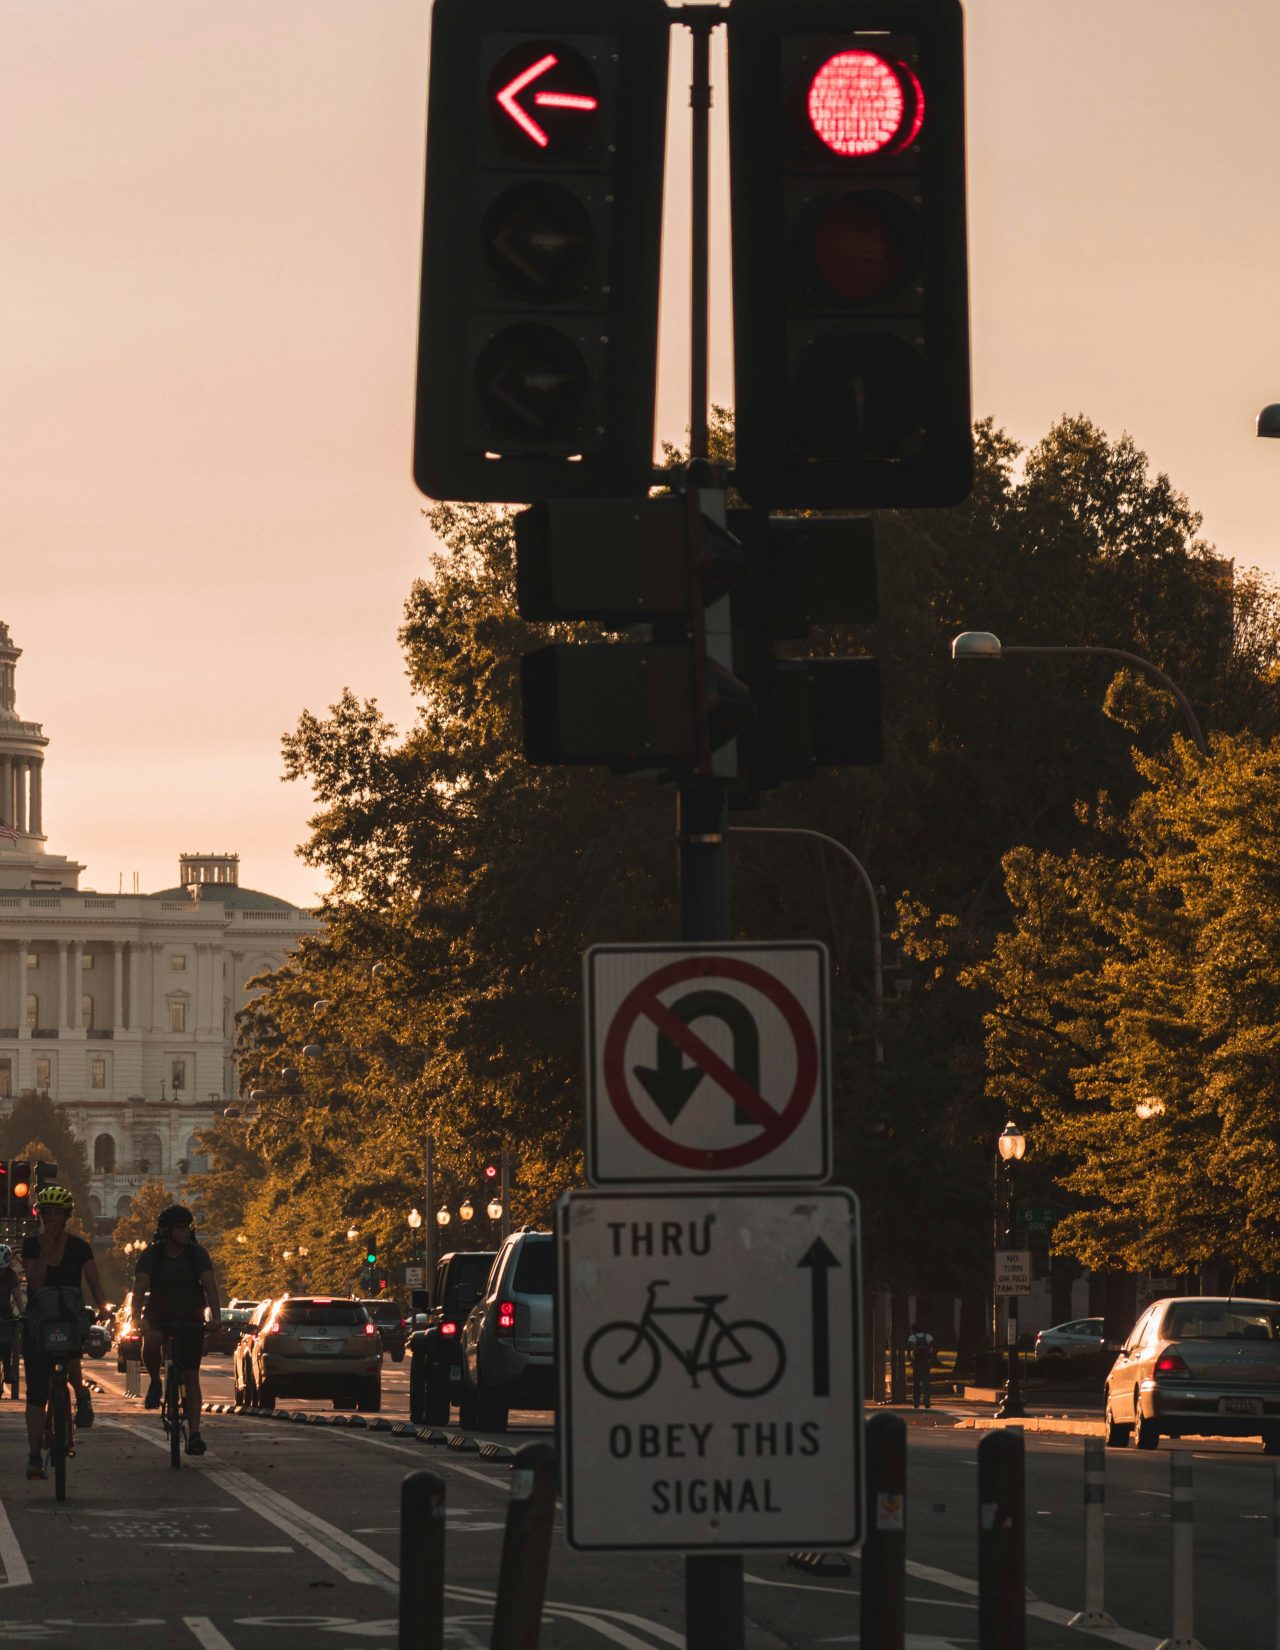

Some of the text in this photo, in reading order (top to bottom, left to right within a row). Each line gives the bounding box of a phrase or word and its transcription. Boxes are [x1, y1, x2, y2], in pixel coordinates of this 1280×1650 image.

[1024, 1209, 1033, 1221] 6
[608, 1221, 713, 1257] THRU
[998, 1274, 1028, 1282] ON RED
[610, 1422, 820, 1458] OBEY THIS
[652, 1479, 782, 1514] SIGNAL
